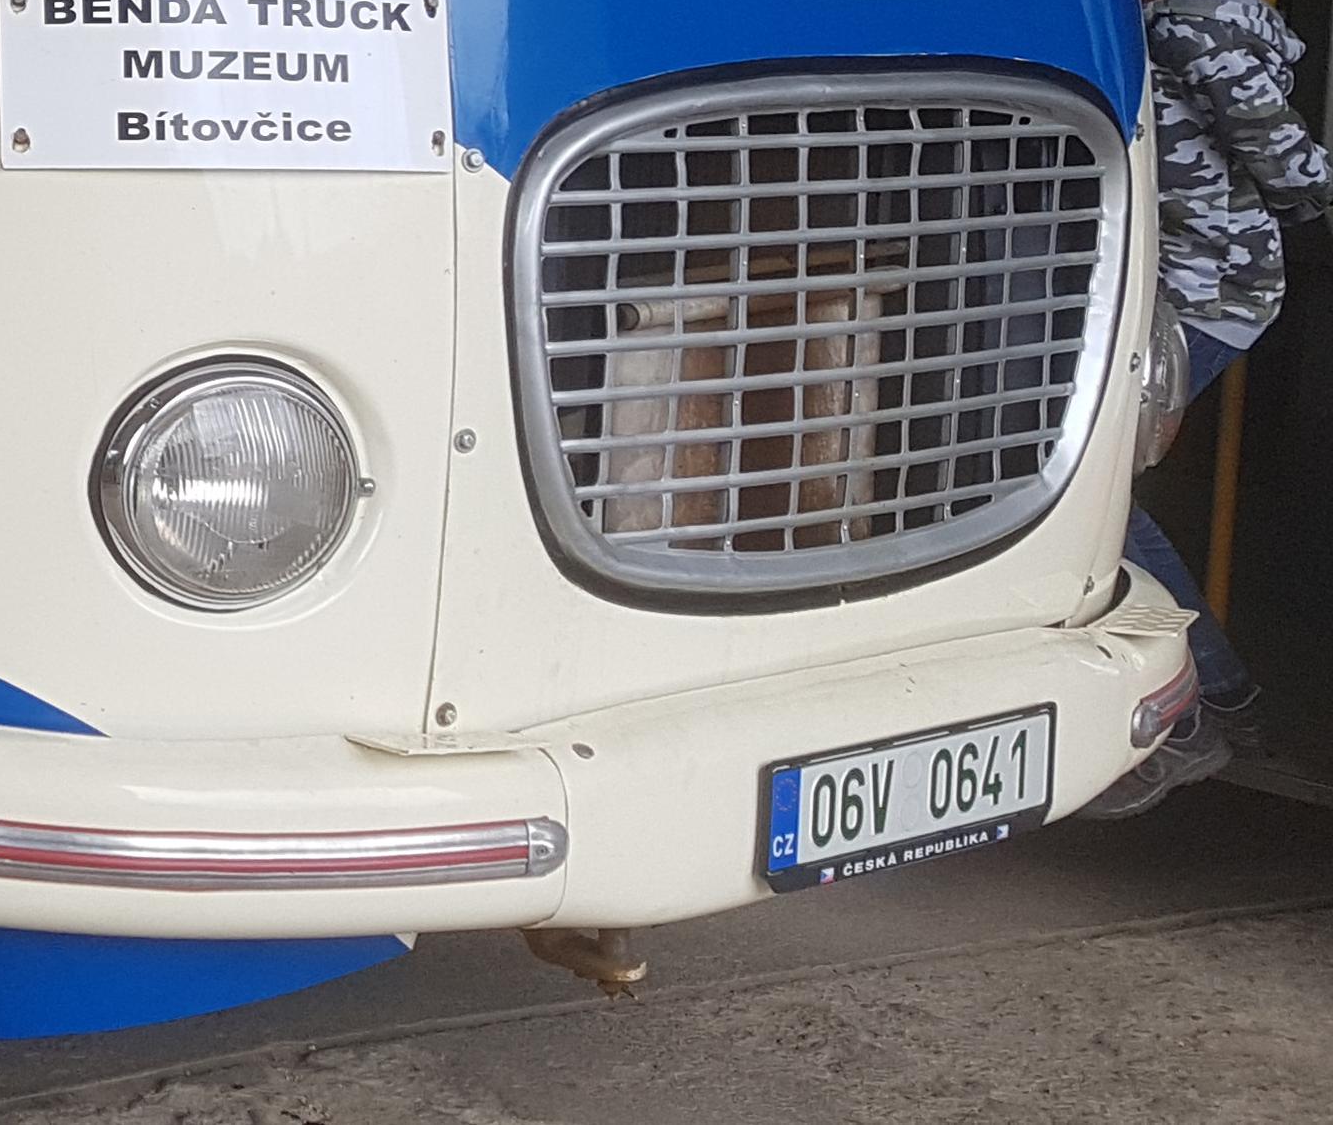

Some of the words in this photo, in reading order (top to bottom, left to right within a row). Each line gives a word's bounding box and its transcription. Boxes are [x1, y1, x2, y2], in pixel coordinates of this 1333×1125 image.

[123, 49, 350, 83] MUZEUM
[117, 111, 353, 142] Bítovčice
[811, 759, 895, 848] 06V
[930, 729, 1029, 819] 0641
[772, 832, 795, 859] CZ
[843, 850, 897, 877] ČESKÁ
[903, 831, 989, 862] REPUBLIKA
